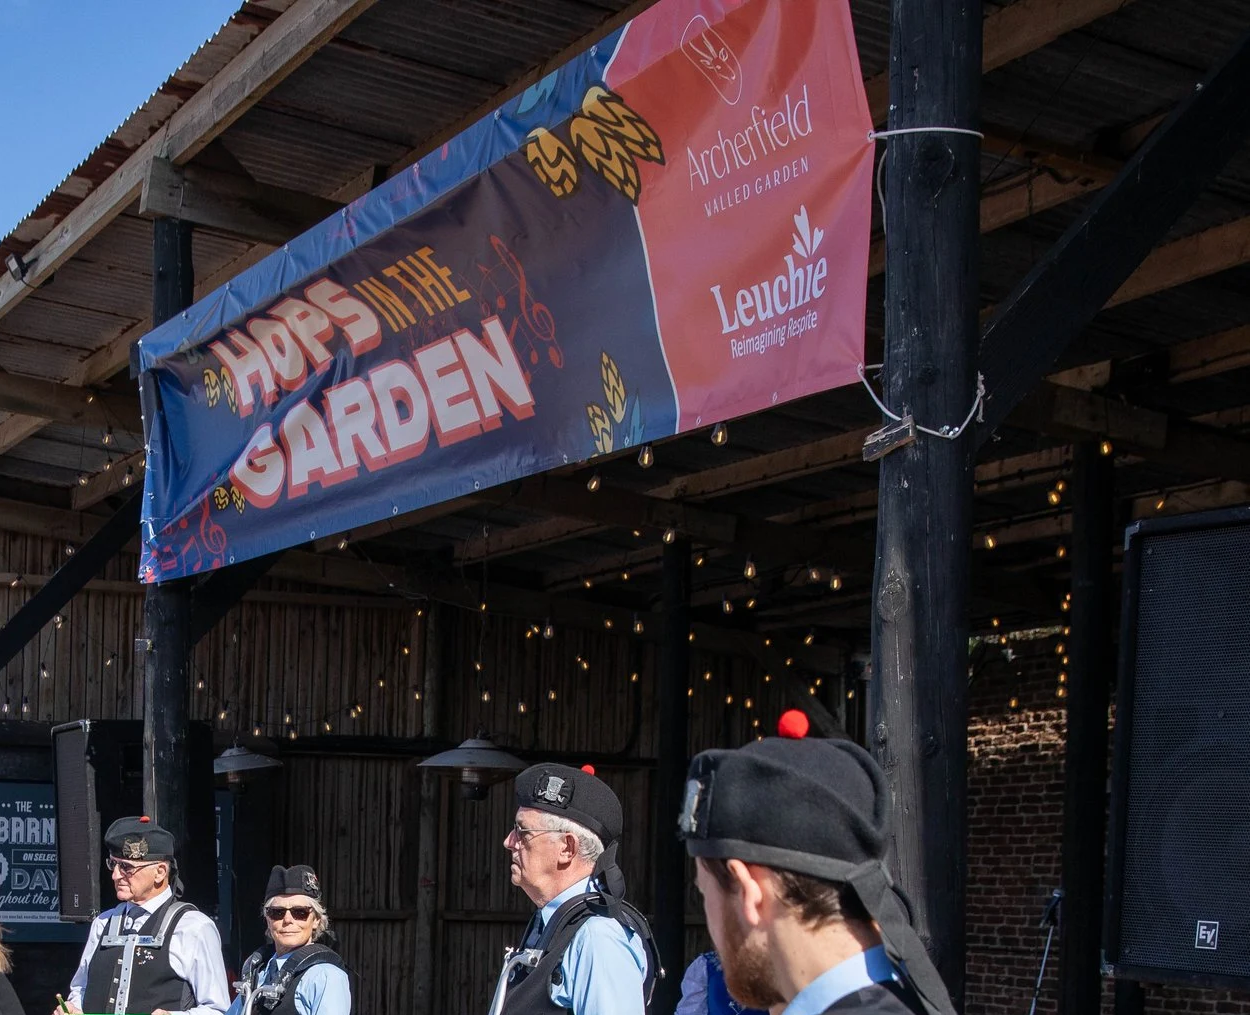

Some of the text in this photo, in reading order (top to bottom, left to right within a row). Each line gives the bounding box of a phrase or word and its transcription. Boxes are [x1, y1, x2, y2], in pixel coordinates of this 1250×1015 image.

[687, 84, 812, 191] Archerfield
[755, 155, 809, 195] GARDEN
[710, 254, 828, 334] Leuchie
[211, 245, 472, 416] HOPS IN THE
[730, 309, 818, 359] Reimagining Respite
[232, 316, 534, 508] GARDEN
[15, 801, 33, 813] THE
[23, 853, 32, 862] ON
[32, 891, 50, 904] the
